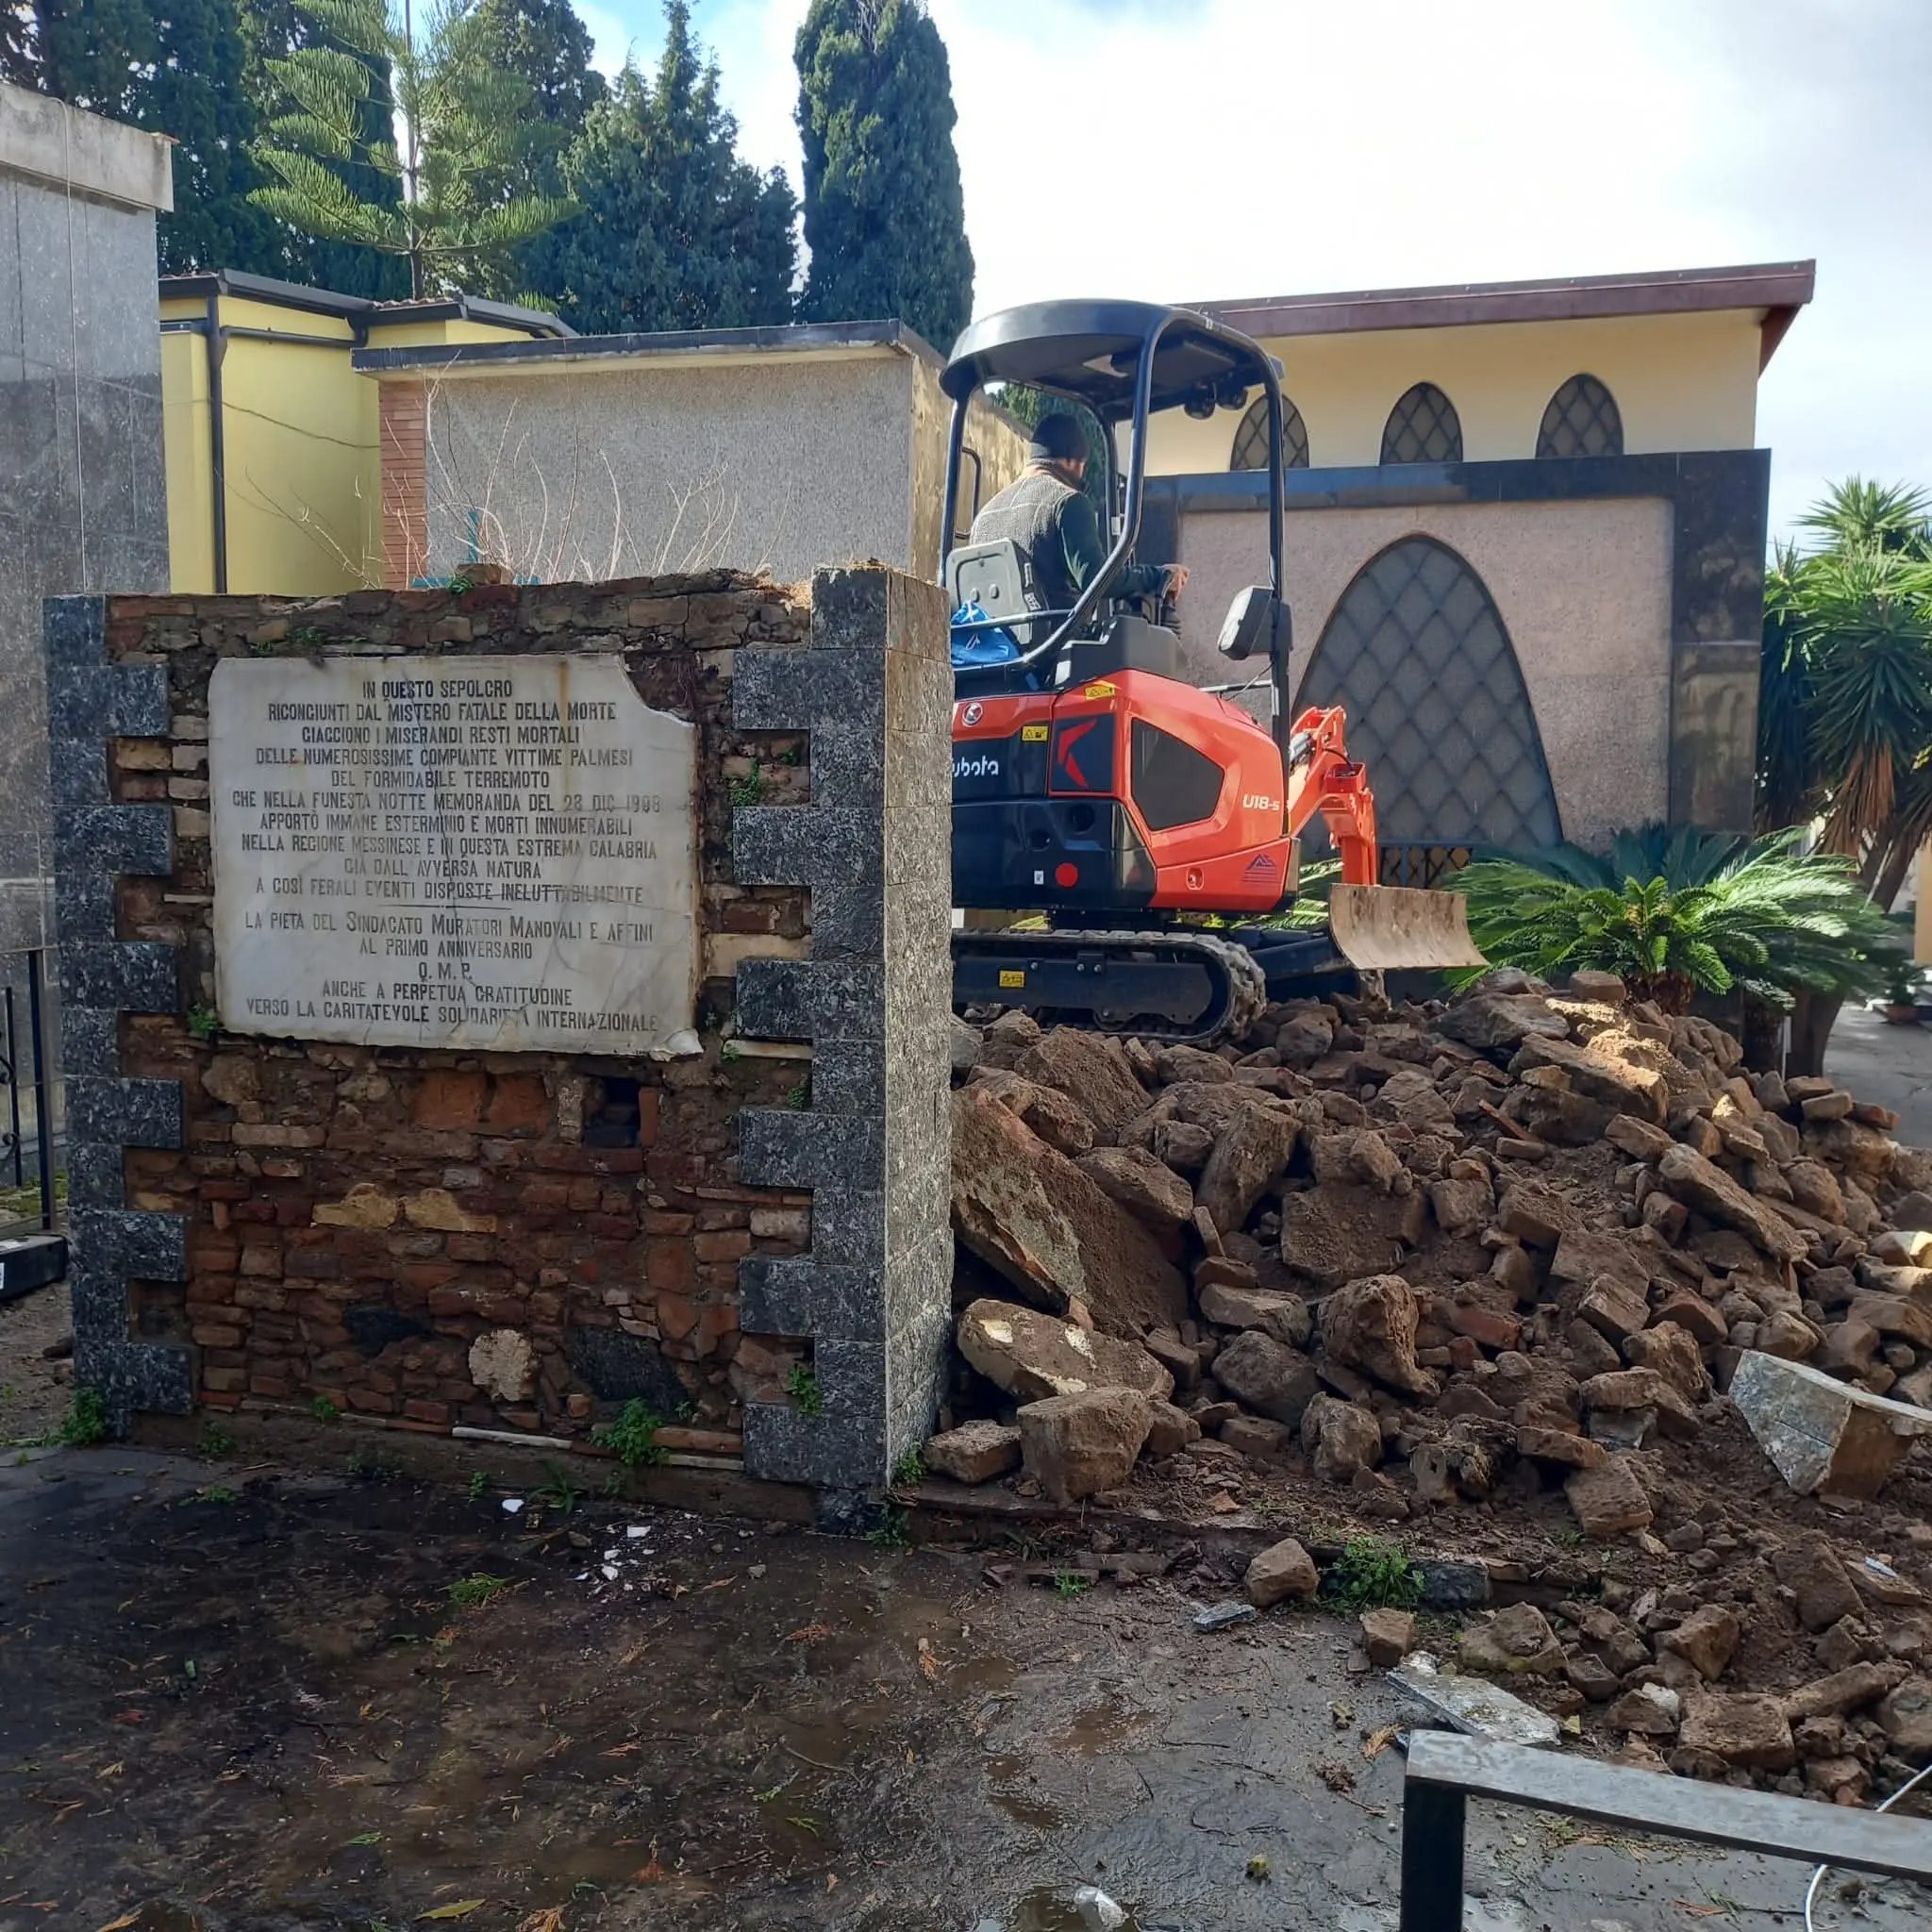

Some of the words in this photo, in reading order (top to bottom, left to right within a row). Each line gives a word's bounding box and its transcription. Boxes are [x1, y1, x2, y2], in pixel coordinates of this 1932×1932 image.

[363, 681, 375, 698] IN
[382, 680, 433, 702] QUESTO
[441, 680, 512, 697] SEPOLCRO
[357, 704, 381, 721] DAL
[388, 704, 450, 721] MISTERO
[458, 703, 507, 720] FATALE
[515, 703, 559, 720] DELLA
[568, 703, 616, 720] MORTE
[386, 726, 462, 743] MISERANDI
[471, 726, 509, 743] RESTI
[518, 726, 579, 743] MORTALI
[257, 748, 297, 764] DELLE
[304, 749, 413, 765] NUMEROSISSIME
[421, 749, 497, 766] COMPIANTE
[506, 749, 562, 766] VITTIME
[571, 749, 633, 766] PALMESI
[952, 755, 1000, 778] ubota
[332, 771, 355, 787] DEL
[365, 771, 456, 788] FORMIDABILE
[464, 771, 549, 788] TERREMOTO
[233, 791, 256, 807] CHE
[264, 791, 306, 808] NELLA
[312, 792, 371, 808] FUNESTA
[379, 793, 426, 809] NOTTE
[434, 793, 521, 811] MEMORANDA
[529, 794, 554, 811] DEL
[260, 809, 319, 830] APPORTÒ
[326, 814, 377, 831] IMMANE
[386, 815, 464, 832] ESTERMINIO
[472, 816, 479, 833] E
[485, 816, 528, 834] MORTI
[536, 817, 632, 836] INNUMERABILI
[242, 834, 284, 851] NELLA
[352, 837, 421, 854] MESSINESE
[427, 838, 435, 855] E
[441, 838, 453, 856] IN
[460, 838, 509, 858] QUESTA
[517, 839, 582, 857] ESTREMA
[590, 841, 658, 858] CALABRIA
[418, 859, 478, 877] AVVERSA
[487, 861, 541, 879] NATURA
[257, 877, 265, 893] A
[311, 879, 356, 896] FERALI
[367, 880, 415, 898] EVENTI
[425, 882, 492, 900] DISPOSTE
[246, 912, 262, 929] LA
[313, 913, 337, 931] DEL
[591, 923, 597, 939] E
[359, 938, 376, 955] AL
[386, 939, 428, 957] PRIMO
[438, 941, 532, 959] ANNIVERSARIO
[323, 980, 366, 997] ANCHE
[377, 983, 385, 999] A
[393, 983, 466, 1002] PERPETUA
[246, 998, 289, 1016] VERSO
[297, 1001, 315, 1017] LA
[324, 1002, 429, 1023] CARITATEVOLE
[537, 1009, 658, 1032] INTERNAZIONALE
